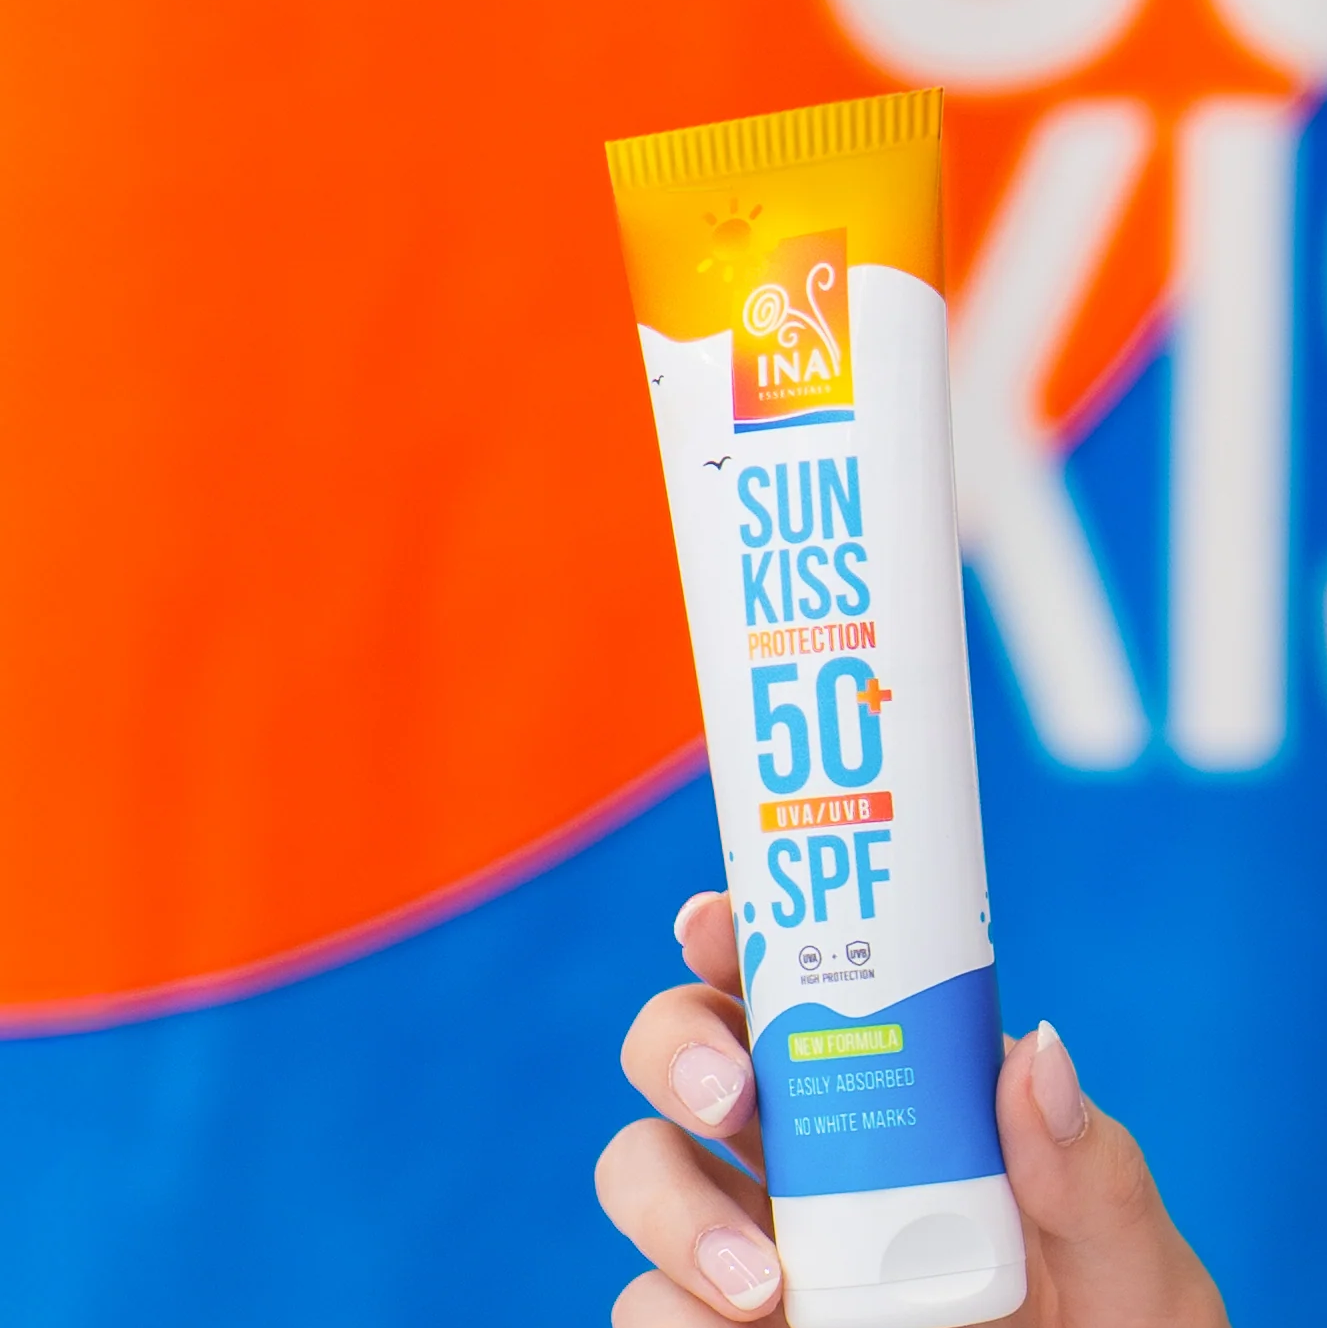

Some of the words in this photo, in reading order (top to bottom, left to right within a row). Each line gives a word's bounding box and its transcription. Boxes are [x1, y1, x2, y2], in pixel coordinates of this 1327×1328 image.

[757, 349, 831, 387] INA
[737, 456, 864, 548] SUN
[741, 542, 871, 626] KISS
[748, 621, 876, 660] PROTECTION
[776, 799, 871, 828] UVA/UVB
[767, 829, 892, 929] SPF
[850, 949, 867, 959] UVB
[822, 969, 875, 983] PROTECTION
[794, 1036, 824, 1056] NEW
[827, 1028, 899, 1053] FORMULA
[788, 1075, 831, 1097] EASILY
[836, 1067, 915, 1092] ABSORBED
[794, 1117, 811, 1136] NO
[814, 1113, 858, 1134] WHITE
[862, 1107, 917, 1129] MARKS
